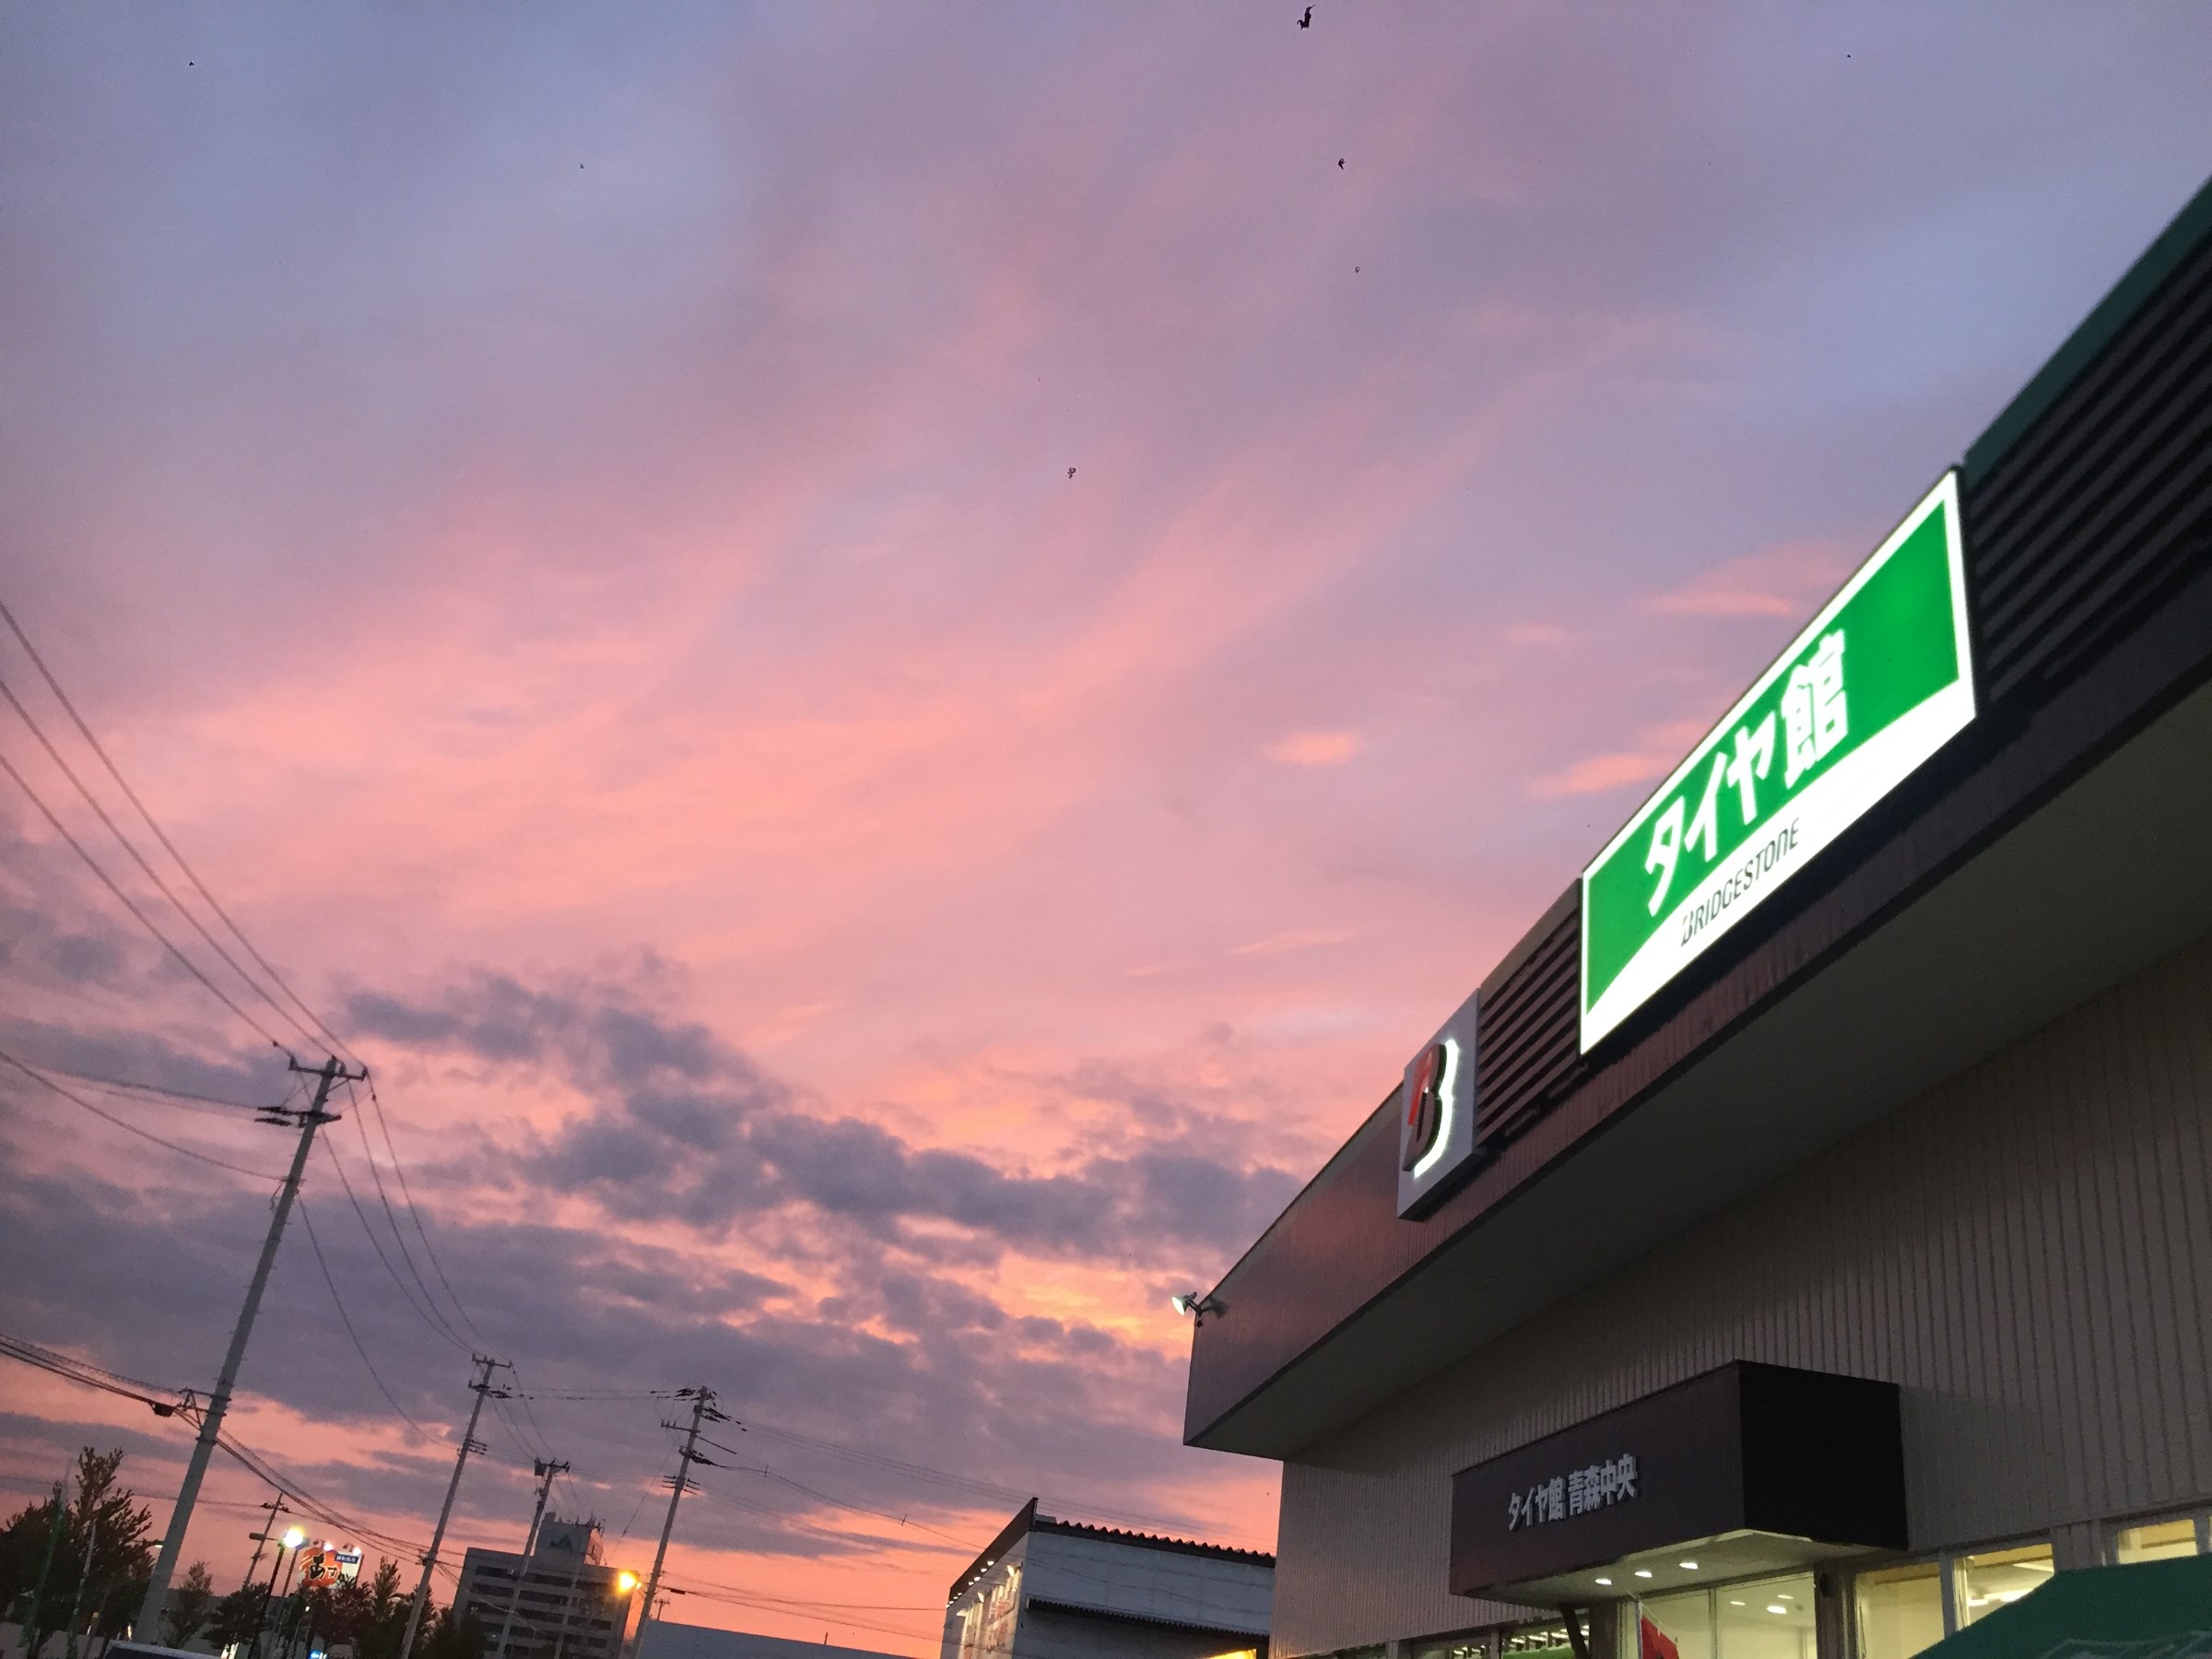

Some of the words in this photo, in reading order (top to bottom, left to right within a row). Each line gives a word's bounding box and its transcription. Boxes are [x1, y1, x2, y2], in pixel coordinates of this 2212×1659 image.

[1644, 628, 1848, 917] タイヤ館
[1680, 817, 1800, 947] BRIDGESTONE
[1508, 1476, 1565, 1532] タイヤ館
[1568, 1453, 1638, 1517] 青森中央
